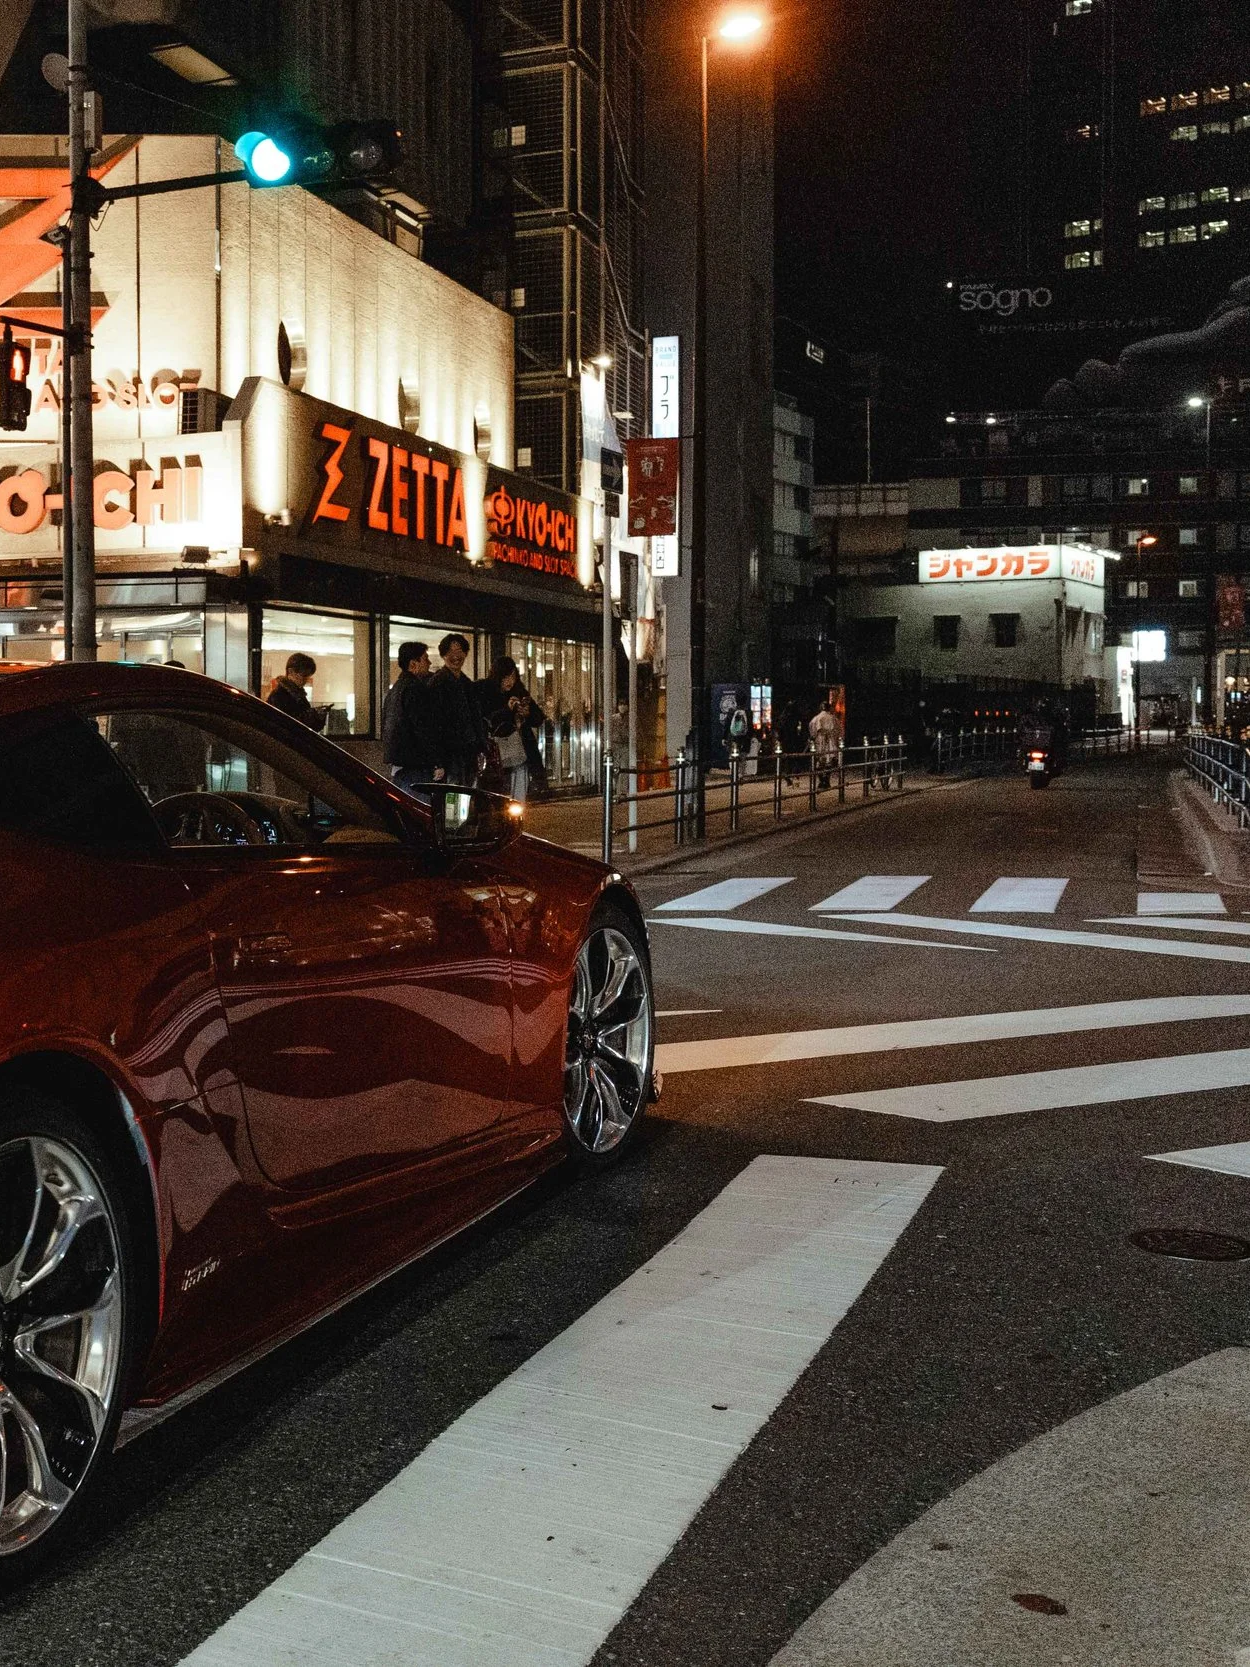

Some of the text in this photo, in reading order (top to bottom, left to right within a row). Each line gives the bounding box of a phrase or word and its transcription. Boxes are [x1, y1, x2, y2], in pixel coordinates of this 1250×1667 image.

[959, 287, 1052, 317] sogno
[34, 382, 109, 413] AD
[369, 437, 470, 553] ZETTA
[516, 498, 575, 554] KYO-ICH
[929, 551, 1050, 579] ジャンカラ
